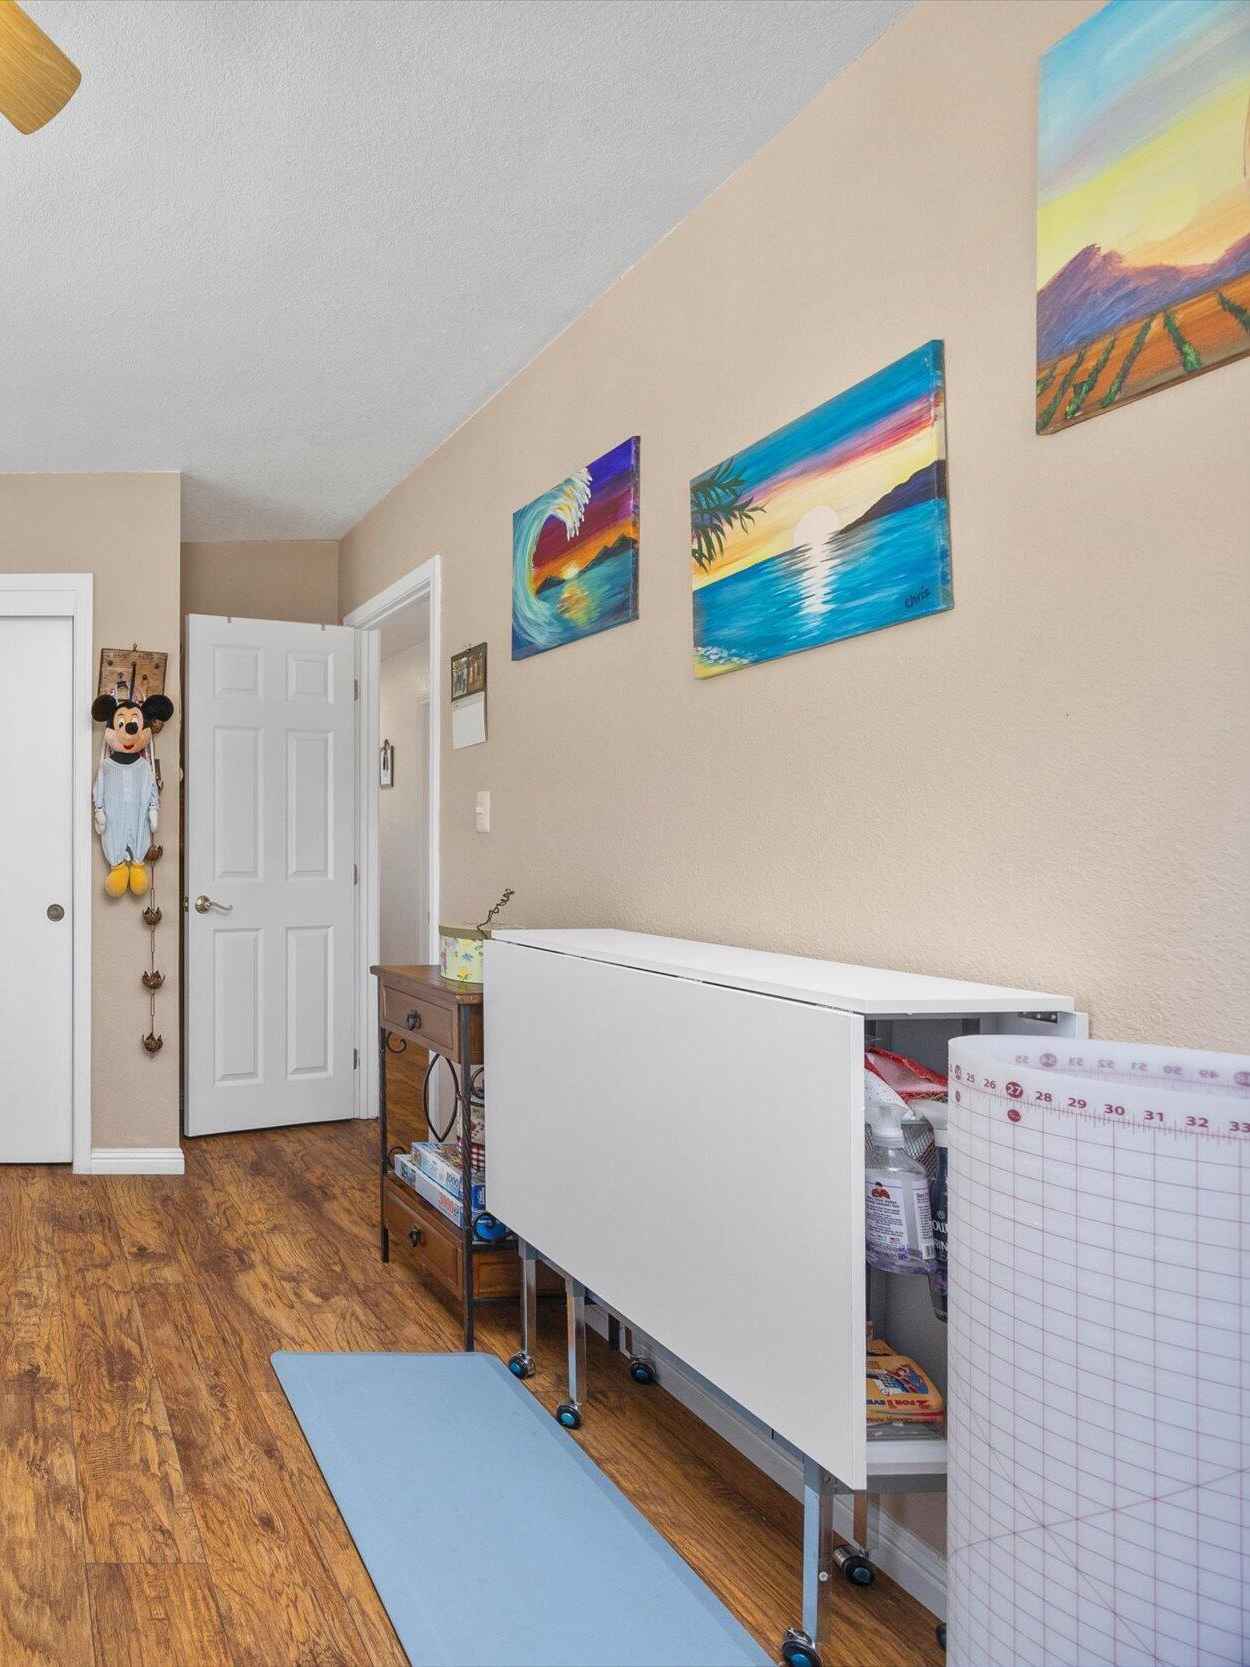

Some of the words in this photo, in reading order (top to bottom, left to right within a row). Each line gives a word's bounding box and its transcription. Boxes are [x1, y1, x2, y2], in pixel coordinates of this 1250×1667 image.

[966, 1072, 975, 1083] 25
[984, 1078, 996, 1090] 26
[1007, 1084, 1022, 1096] 27
[1035, 1090, 1053, 1102] 28
[1068, 1097, 1087, 1109] 29
[1104, 1104, 1125, 1116] 30
[1144, 1110, 1165, 1122] 31
[1186, 1115, 1209, 1128] 32
[1229, 1120, 1250, 1133] 33
